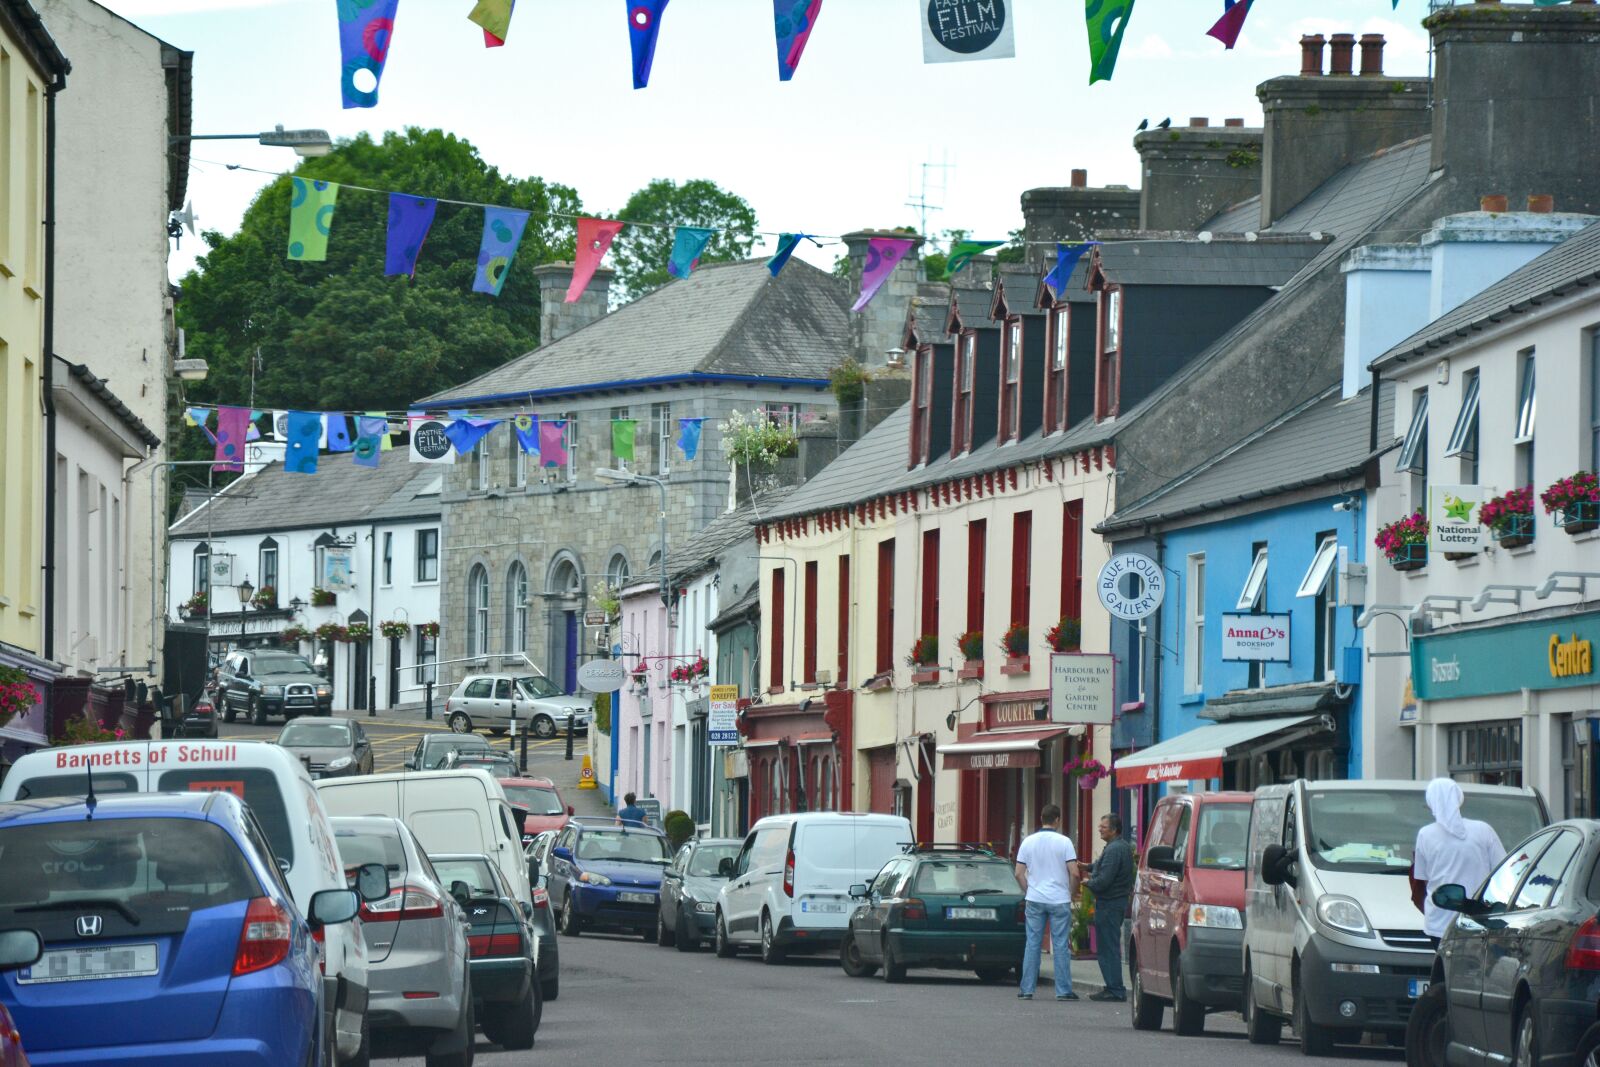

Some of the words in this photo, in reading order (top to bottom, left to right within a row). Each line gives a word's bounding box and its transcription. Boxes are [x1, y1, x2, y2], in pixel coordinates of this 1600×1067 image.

[937, 0, 996, 30] FILM
[941, 21, 1000, 41] FESTIVAL
[418, 436, 448, 446] FILM
[1437, 526, 1481, 534] National
[1440, 534, 1478, 544] Lottery
[1103, 560, 1124, 588] BLUE
[1126, 557, 1160, 590] HOUSE
[1106, 592, 1156, 614] GALLERY
[1548, 632, 1592, 678] Centra
[996, 703, 1036, 722] COURTYA
[1066, 703, 1097, 711] CENTRE
[56, 748, 141, 768] Barnetts
[149, 746, 168, 764] of
[178, 745, 237, 762] Schull
